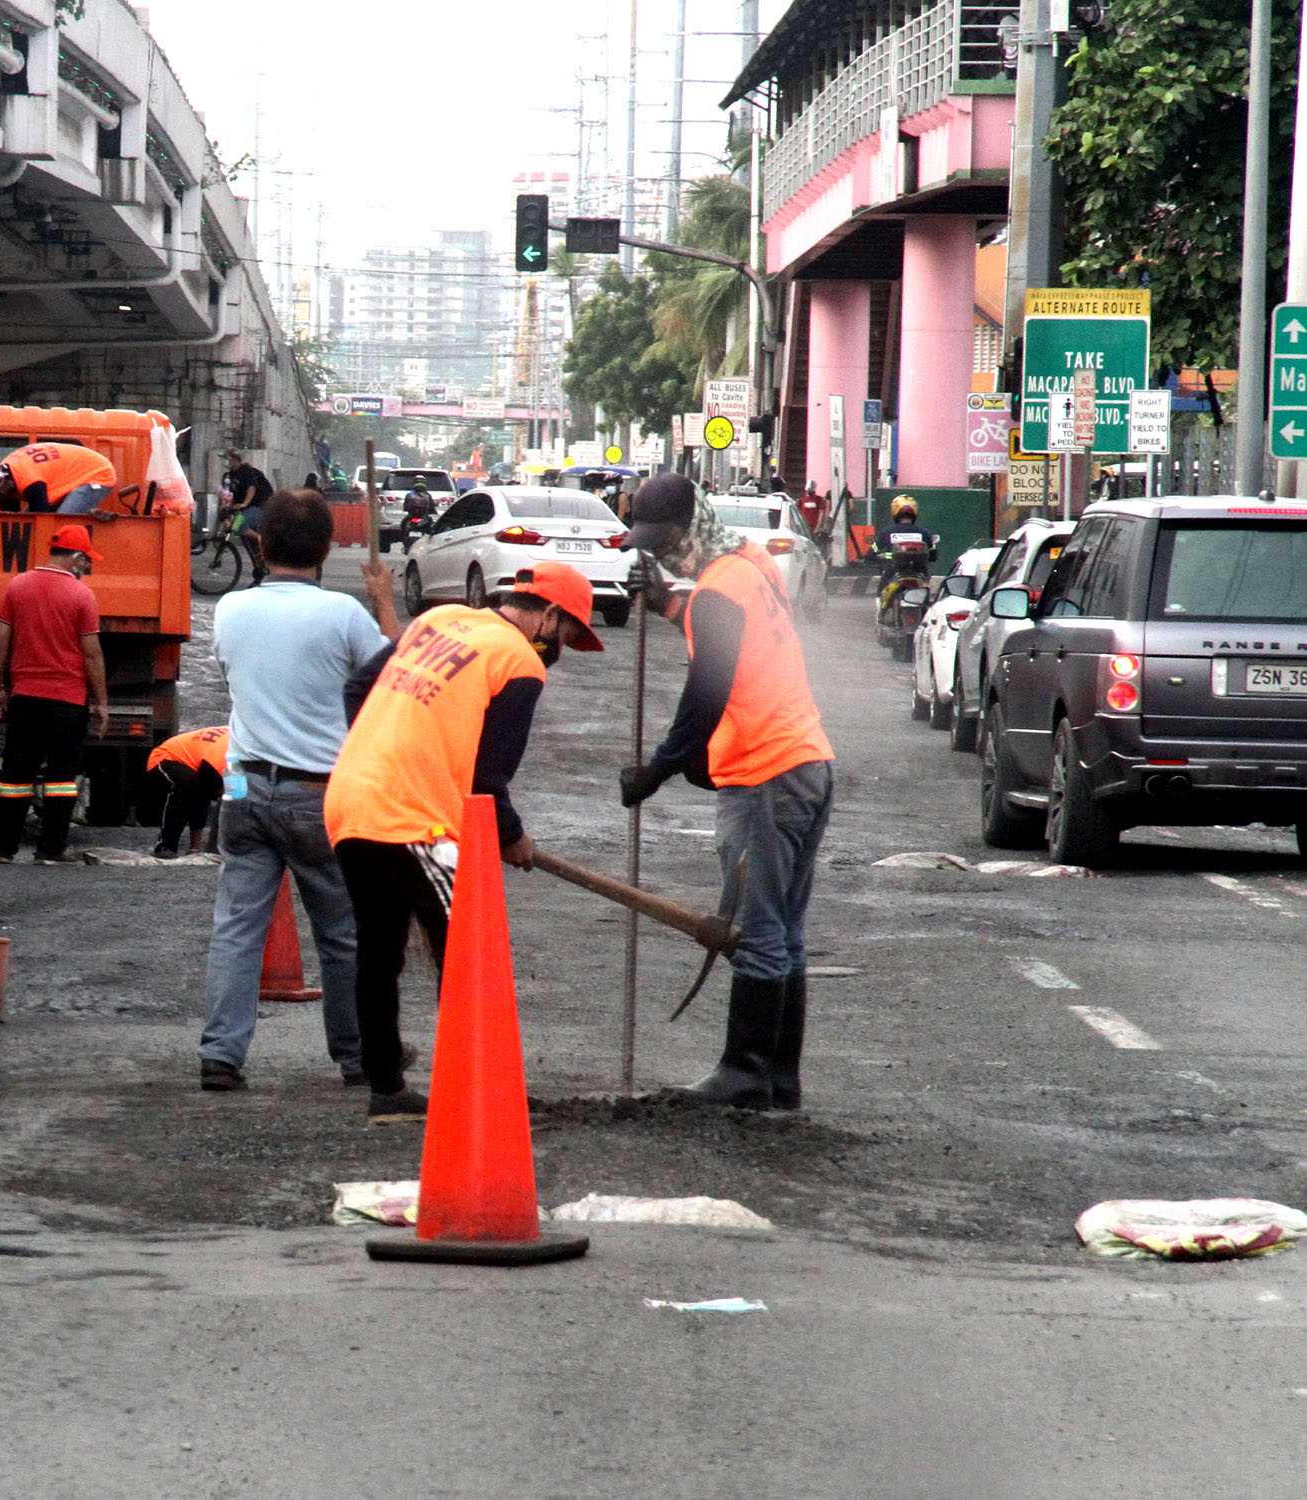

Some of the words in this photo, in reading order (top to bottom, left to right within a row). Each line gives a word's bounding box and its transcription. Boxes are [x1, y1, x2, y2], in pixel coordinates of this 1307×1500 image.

[1033, 302, 1098, 314] ALTERNATE
[1102, 302, 1142, 314] ROUTE
[1064, 351, 1105, 369] TAKE
[1280, 366, 1306, 391] Ma
[709, 383, 722, 392] ALL
[725, 383, 746, 392] BUSES
[1027, 375, 1099, 394] MACAPA
[352, 400, 381, 409] DAVIES
[1137, 398, 1162, 406] RIGHT
[1134, 411, 1165, 419] TURNER
[1133, 424, 1155, 432] YIELD
[1157, 424, 1167, 432] TO
[1137, 438, 1161, 446] BIKES
[970, 454, 992, 466] BIKE
[1010, 464, 1029, 475] DO
[1032, 464, 1057, 475] NOT
[1013, 478, 1054, 488] BLOCK
[1202, 640, 1281, 650] RANGE
[1252, 668, 1282, 685] ZSN
